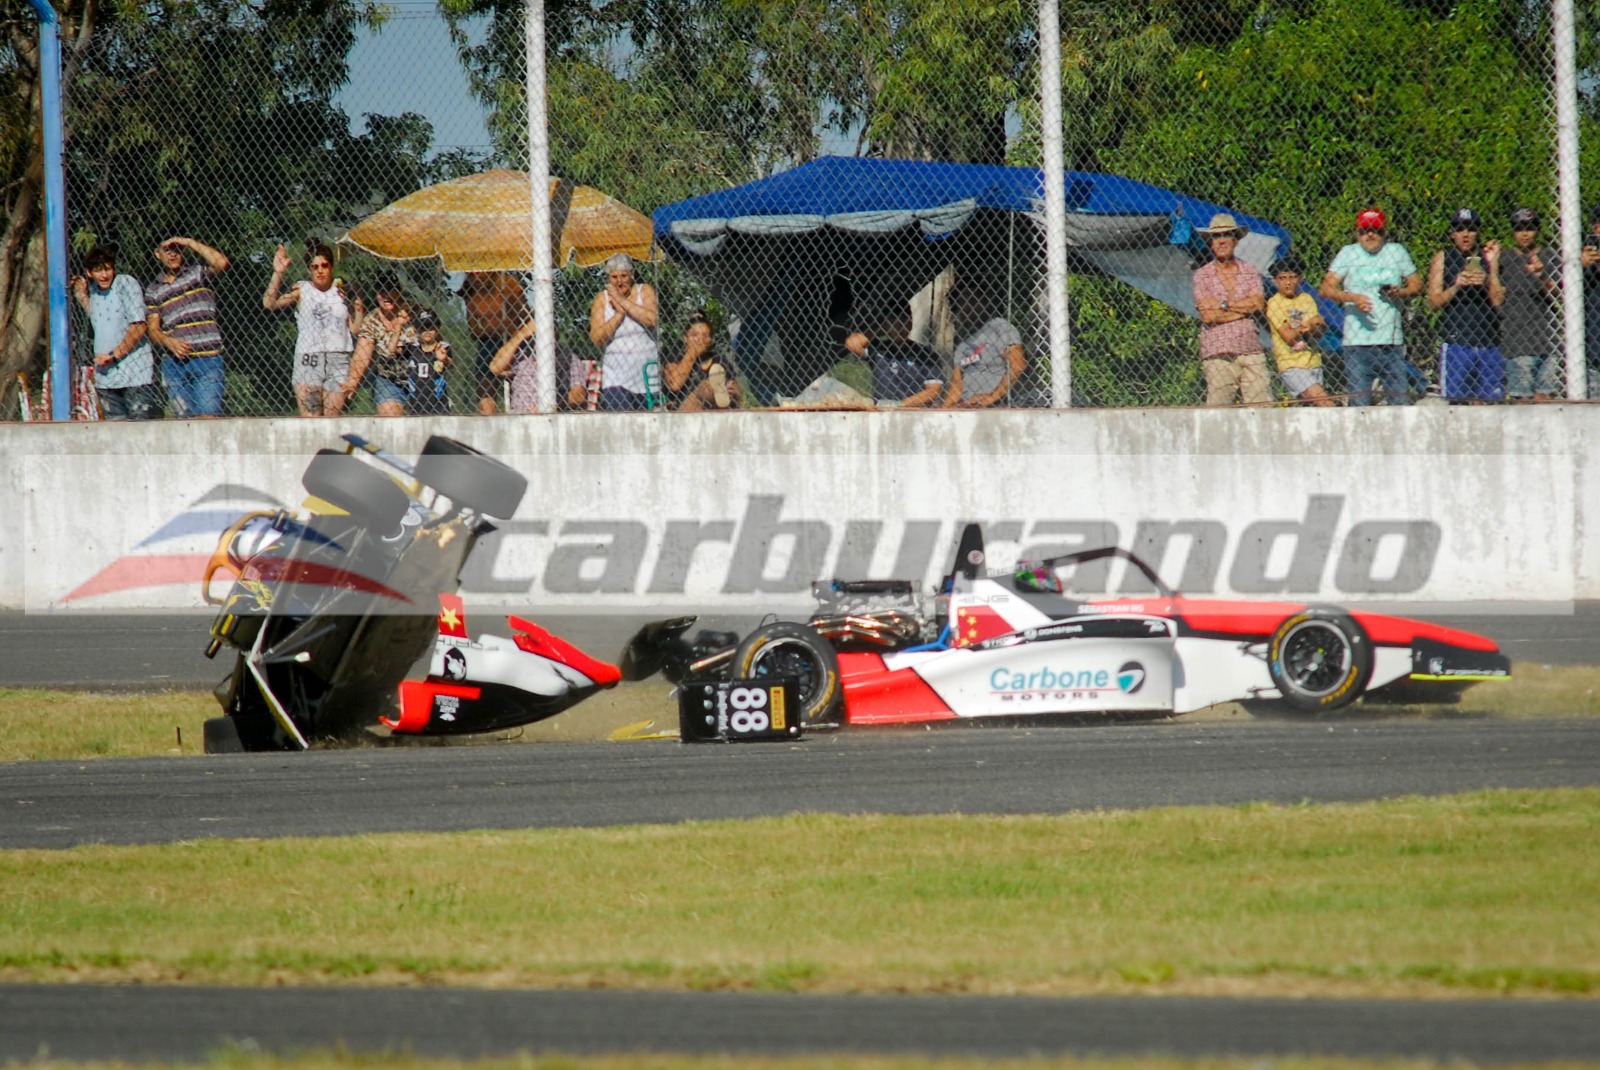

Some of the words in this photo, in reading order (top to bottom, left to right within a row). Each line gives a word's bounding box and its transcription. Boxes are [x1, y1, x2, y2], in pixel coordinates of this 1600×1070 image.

[990, 667, 1109, 690] Carbone
[1001, 691, 1099, 701] MOTORS
[730, 687, 769, 733] 88
